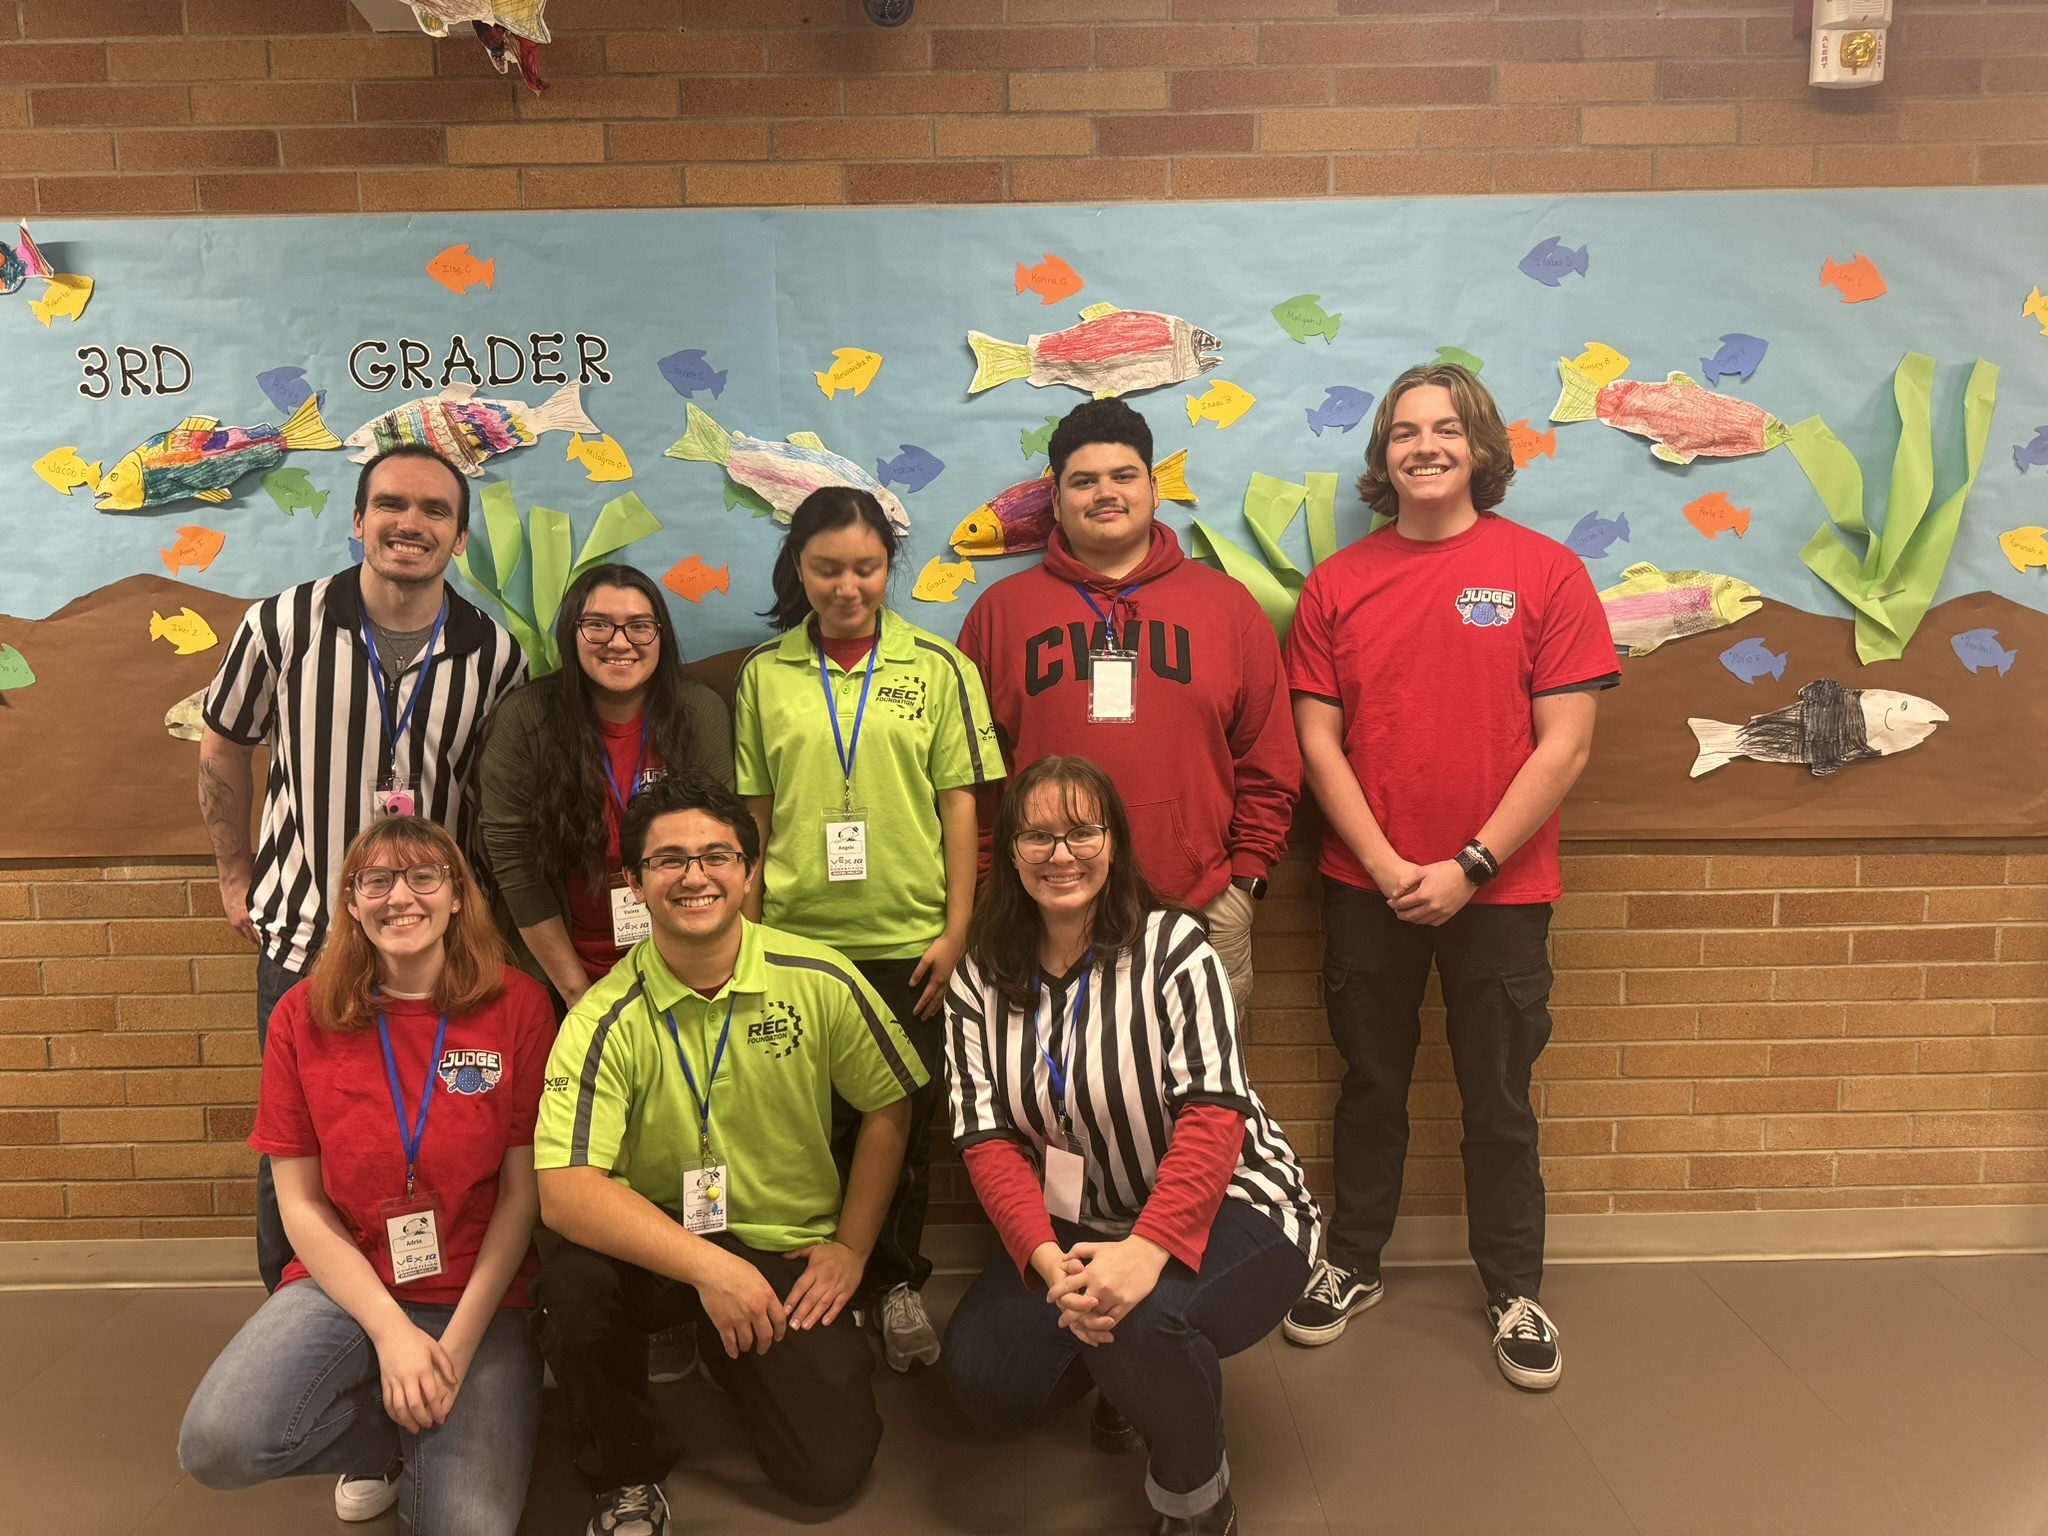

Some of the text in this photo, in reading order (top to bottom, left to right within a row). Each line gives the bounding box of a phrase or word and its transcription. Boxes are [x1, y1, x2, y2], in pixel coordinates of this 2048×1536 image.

[1821, 36, 1829, 69] ALERT
[77, 332, 613, 398] 3RD GRADER
[1511, 439, 1533, 452] nsley
[48, 462, 77, 478] Jacob
[678, 574, 697, 583] Ian
[926, 576, 947, 592] Grace
[1460, 590, 1513, 606] JUDGE
[1025, 619, 1193, 697] CWU
[875, 696, 915, 706] FOUNDATION
[877, 686, 919, 701] REC
[830, 857, 852, 865] VEX
[617, 922, 638, 932] VEX
[748, 1018, 788, 1037] REC
[747, 1032, 788, 1045] FOUNDATION
[442, 1052, 499, 1068] JUDGE
[687, 1210, 711, 1220] VEX
[396, 1254, 423, 1266] VEX
[425, 1253, 437, 1261] IQ
